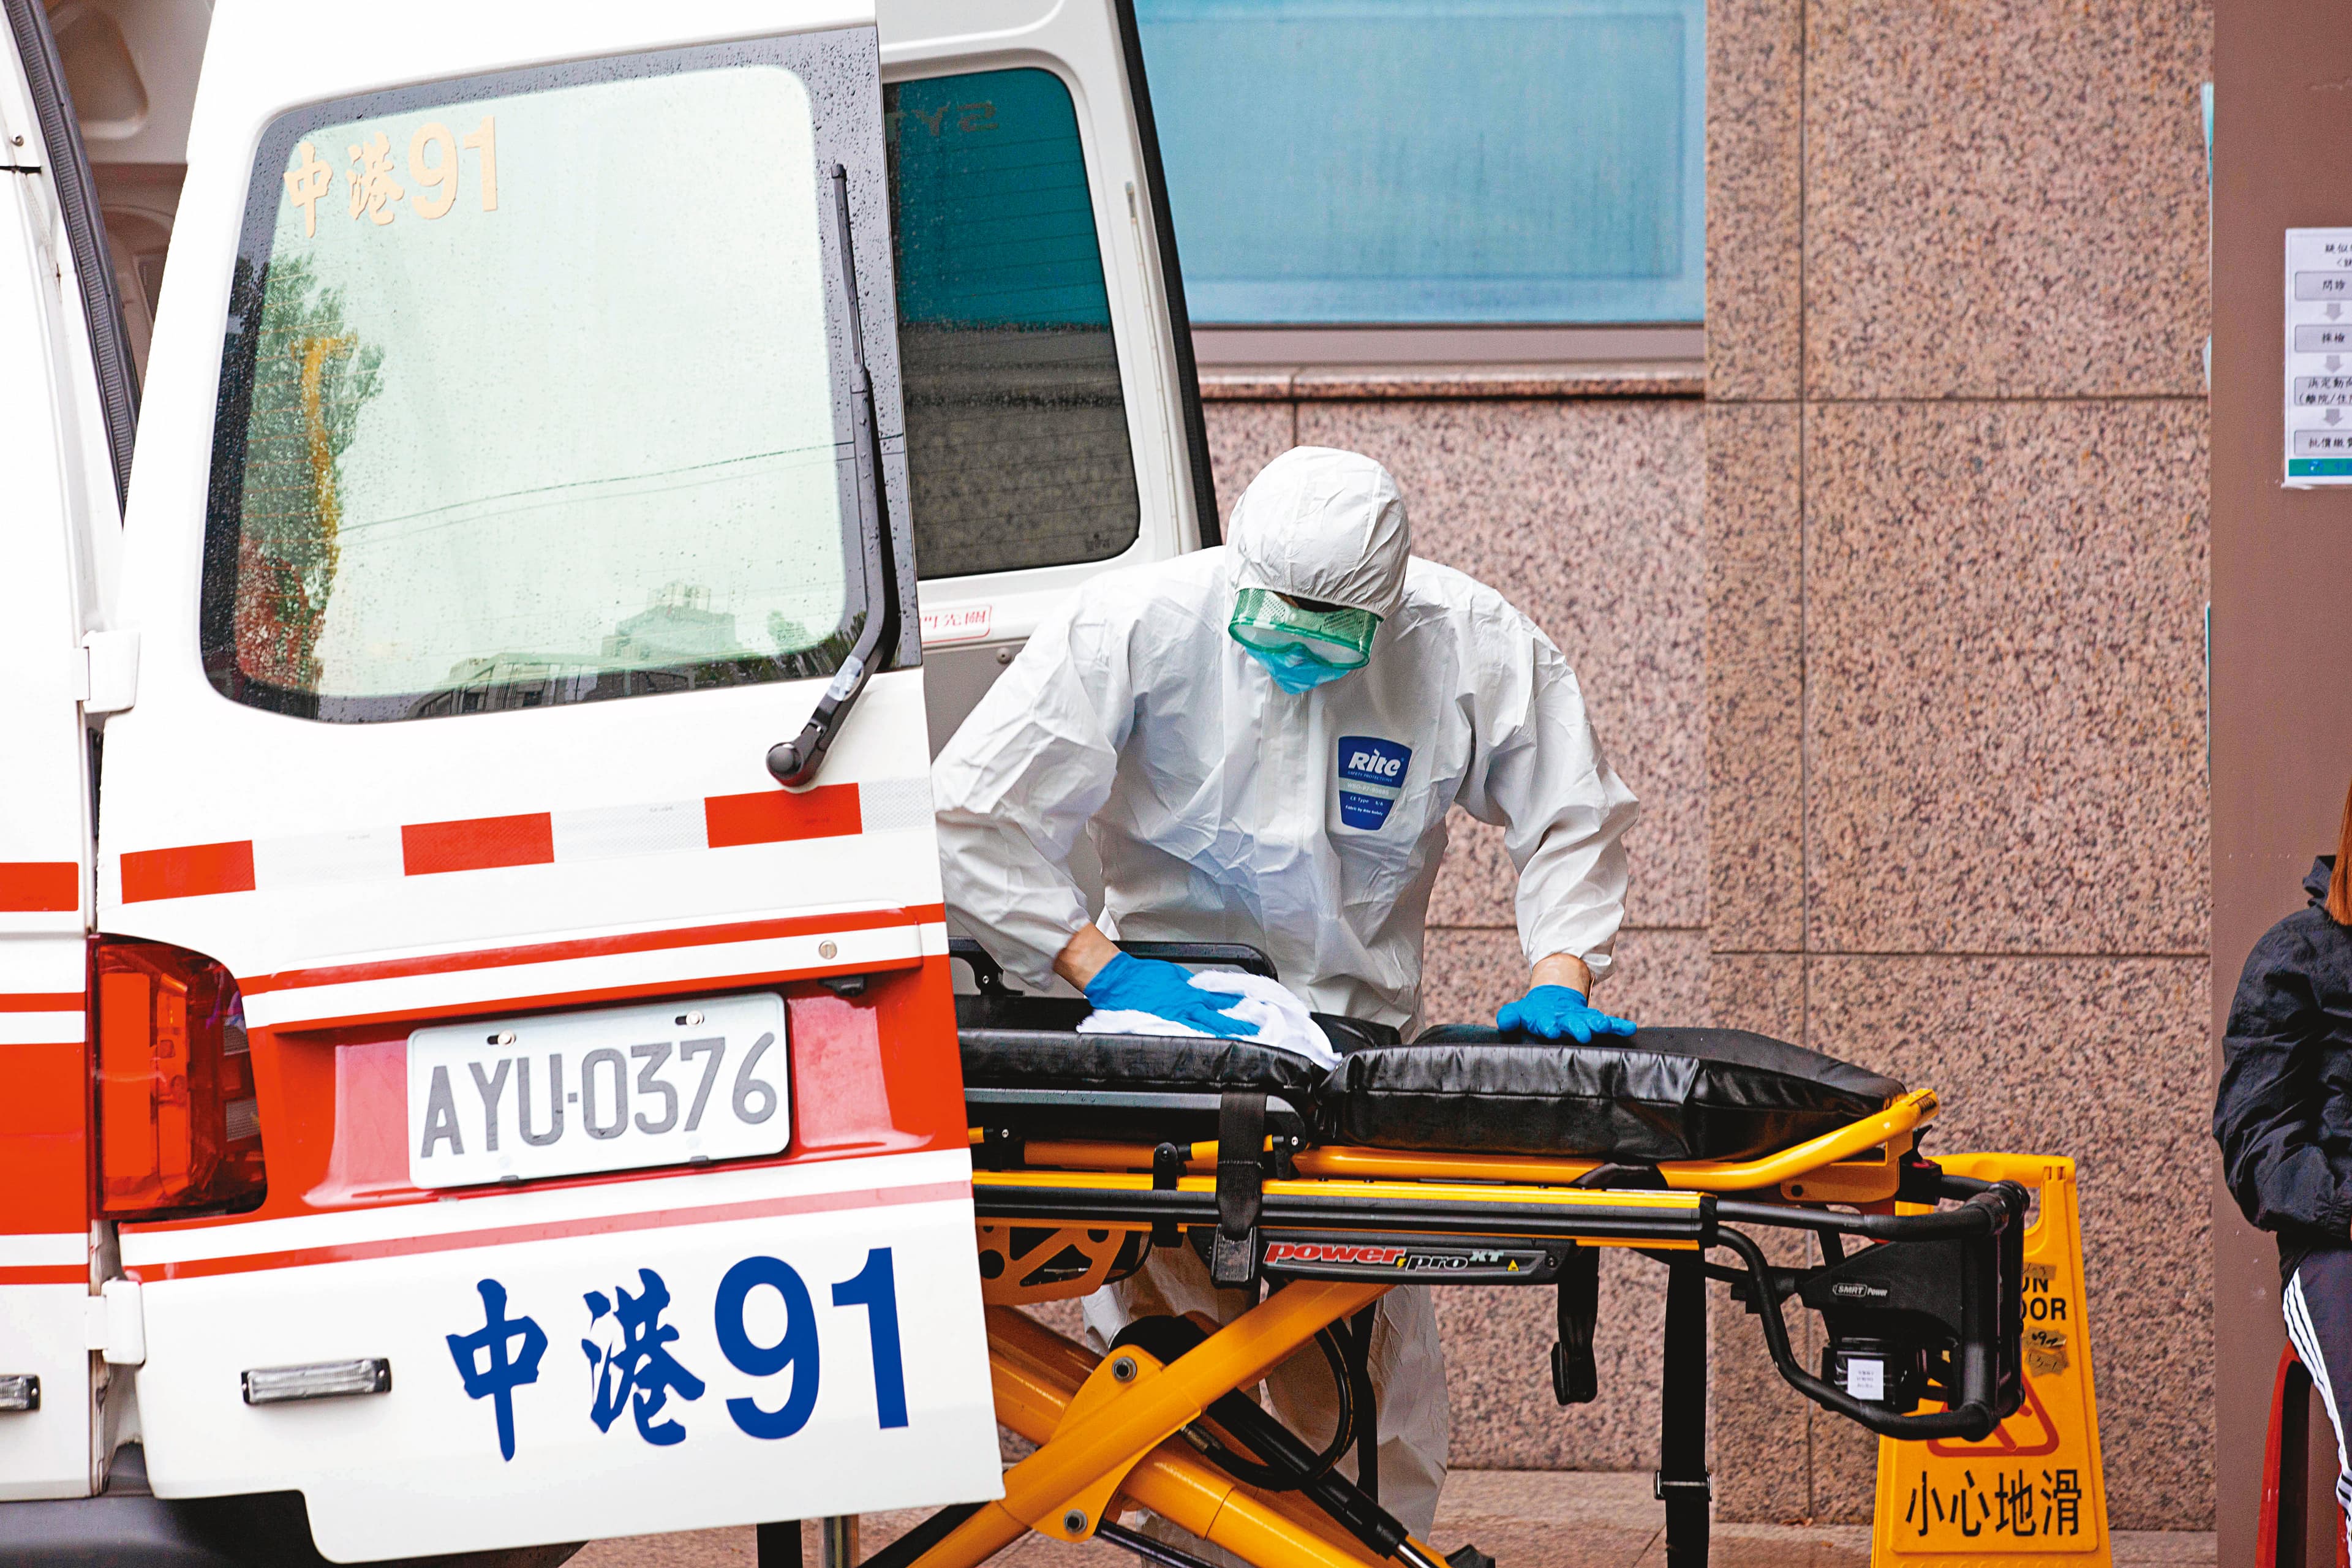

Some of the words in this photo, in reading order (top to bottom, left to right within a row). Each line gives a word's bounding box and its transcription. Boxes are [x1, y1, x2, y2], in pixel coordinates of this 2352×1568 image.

[284, 115, 498, 238] 中港91
[1348, 748, 1401, 777] Rite
[1262, 1241, 1407, 1265] power
[1406, 1254, 1468, 1272] pro
[1470, 1249, 1505, 1263] XT
[1838, 1285, 1864, 1295] SMRT
[1867, 1287, 1888, 1297] Power
[445, 1246, 909, 1462] 中港91
[1905, 1469, 2081, 1538] 小心地滑
